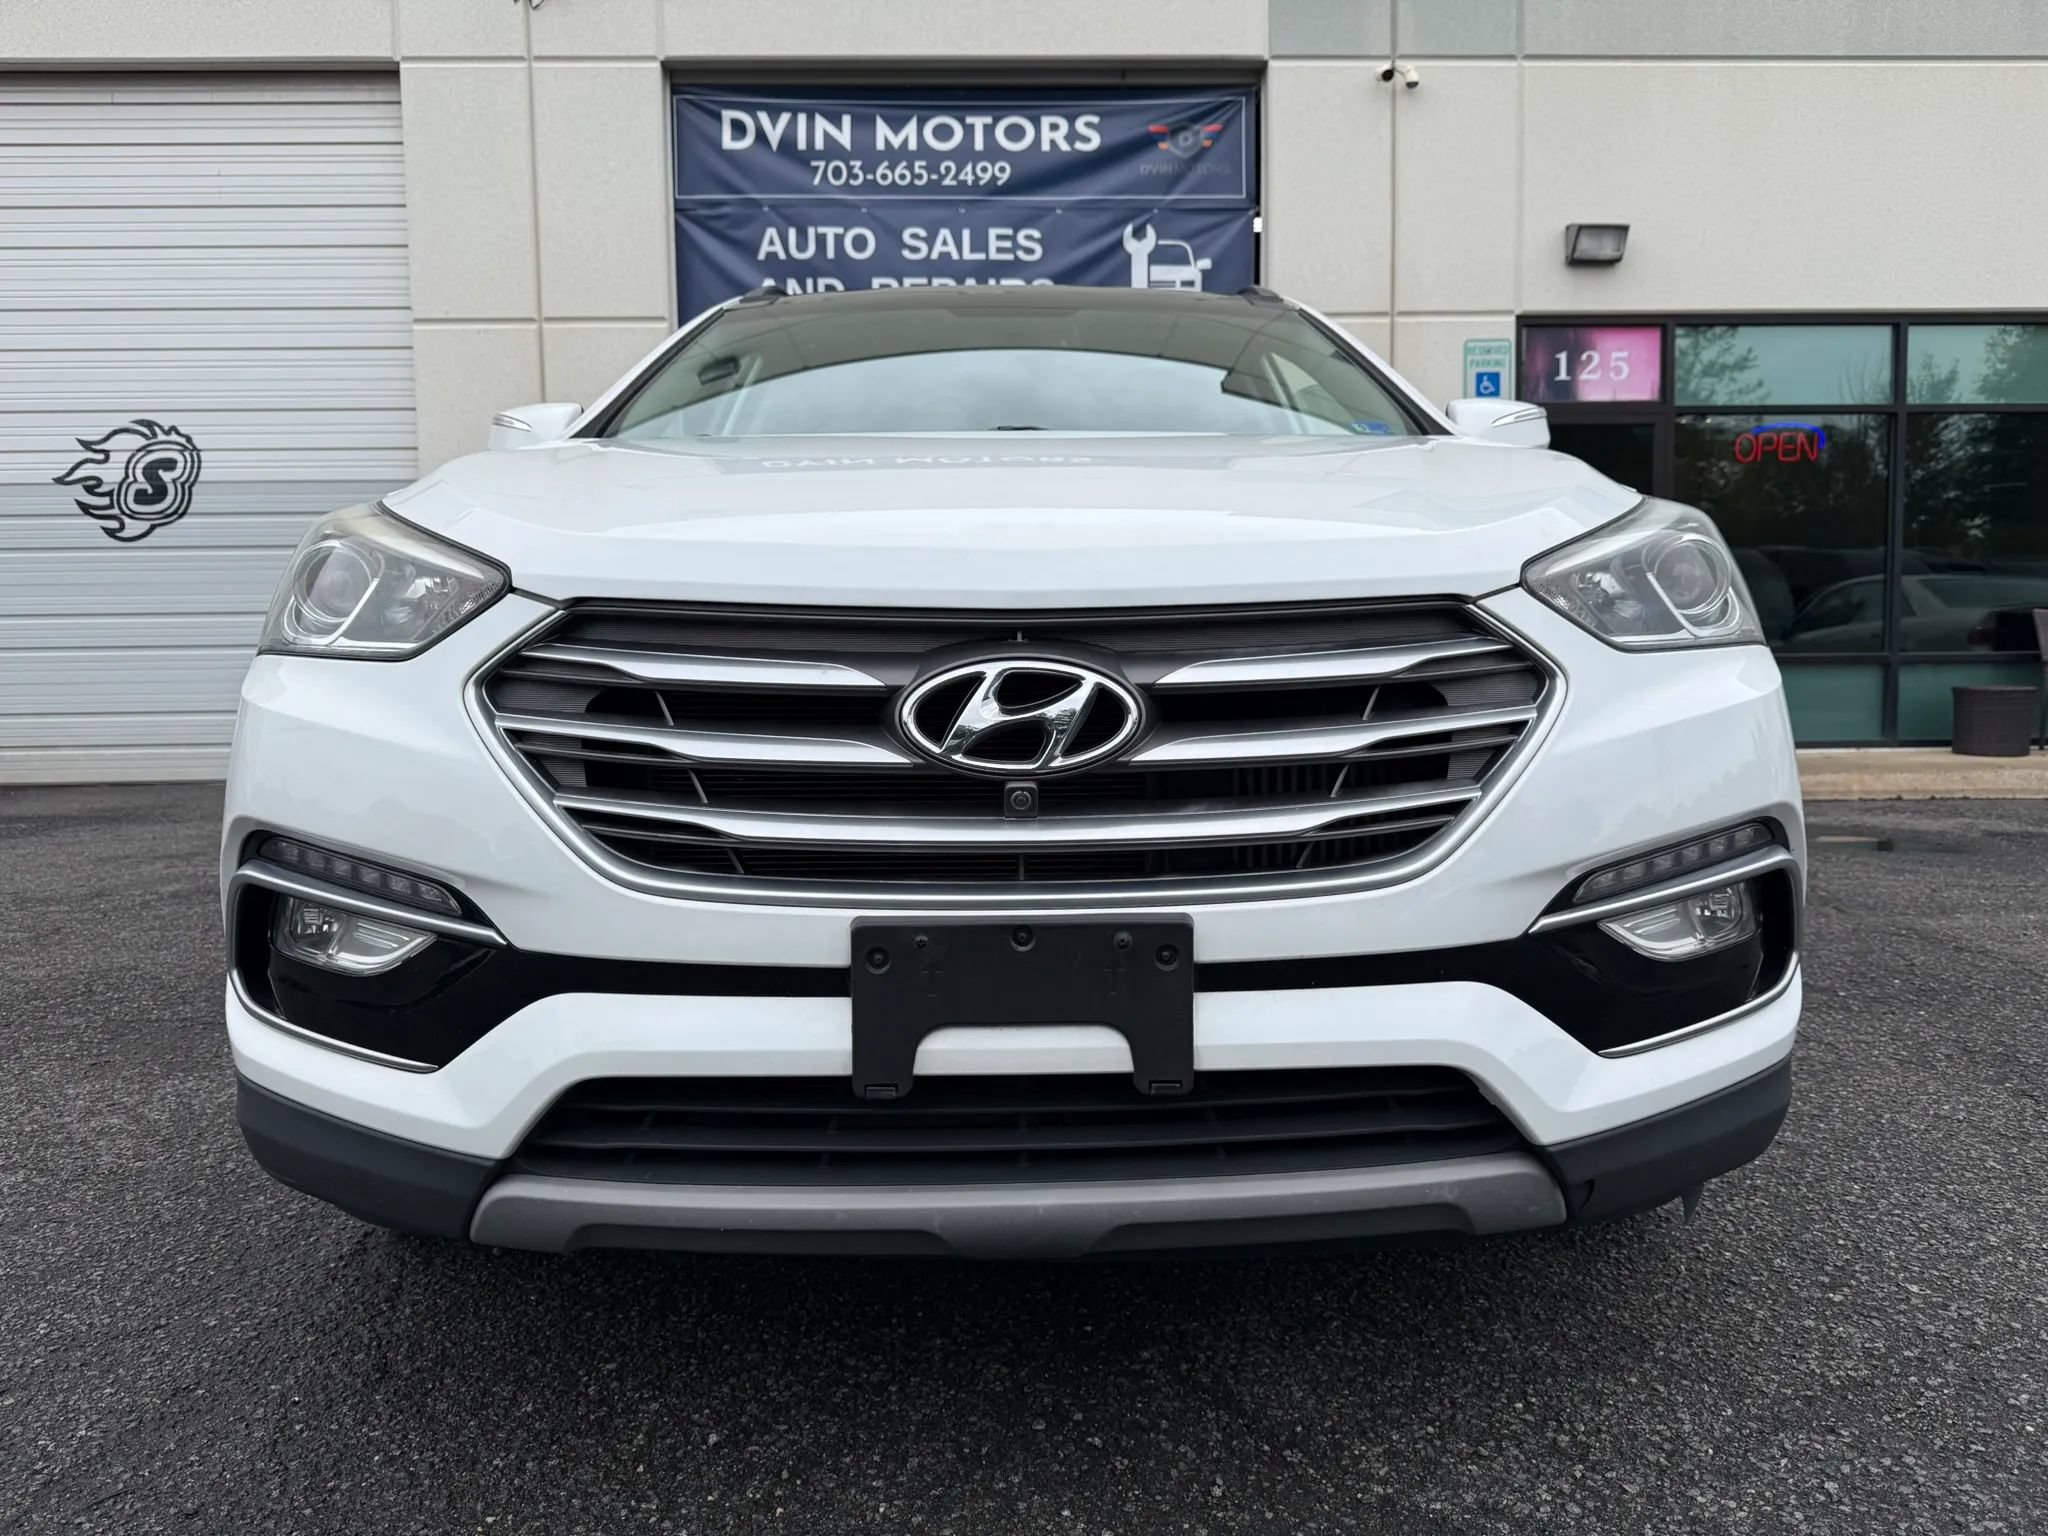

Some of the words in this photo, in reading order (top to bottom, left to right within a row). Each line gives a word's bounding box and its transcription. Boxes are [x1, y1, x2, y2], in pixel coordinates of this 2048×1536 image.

[720, 109, 852, 152] DVIN
[875, 113, 1101, 152] MOTORS
[810, 160, 1011, 186] 703-665-2499
[757, 226, 876, 260] AUTO
[901, 227, 1043, 261] SALES
[1469, 358, 1506, 369] PARKING
[1554, 350, 1629, 381] 125
[1734, 431, 1819, 464] OPEN
